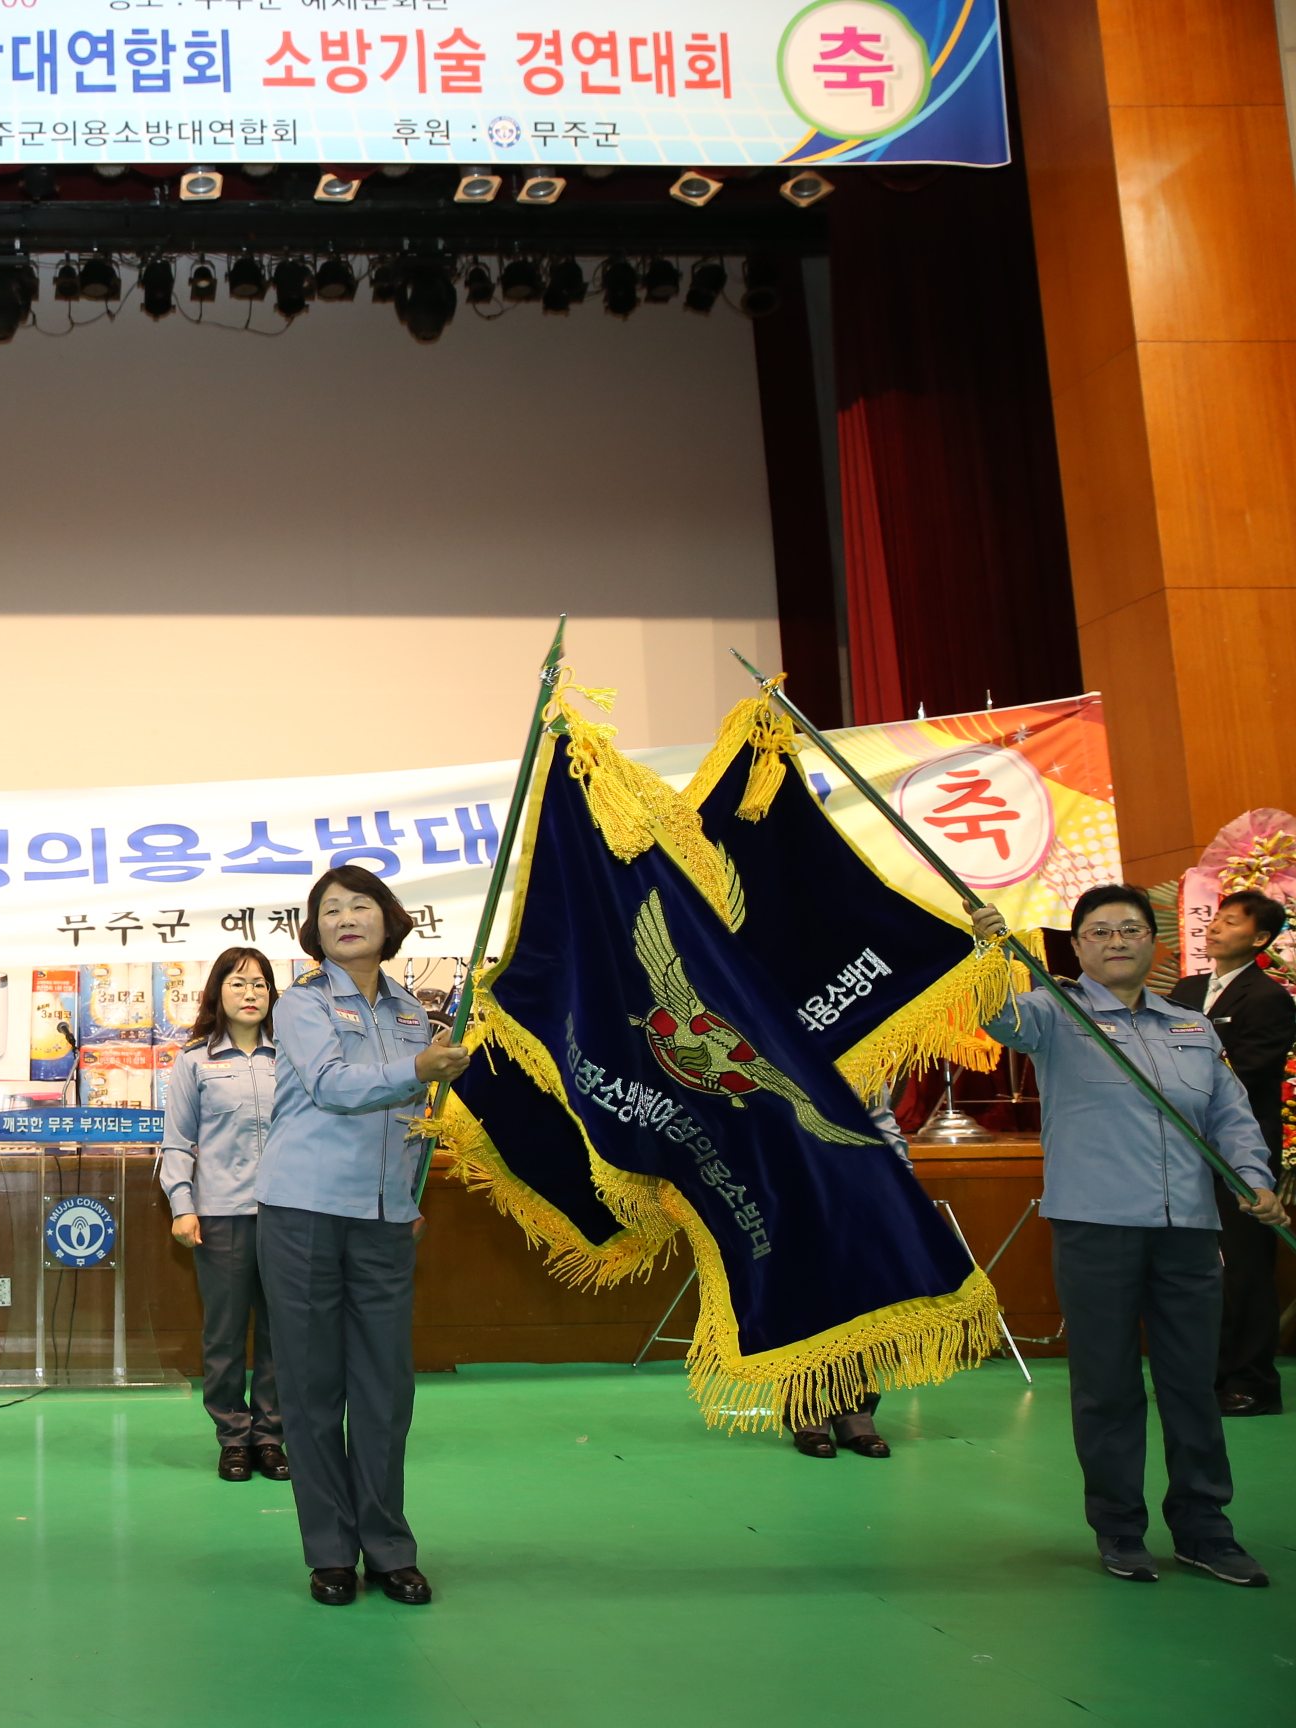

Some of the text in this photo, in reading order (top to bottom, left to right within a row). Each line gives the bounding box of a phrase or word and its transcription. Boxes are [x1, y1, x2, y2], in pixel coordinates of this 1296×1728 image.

[262, 26, 487, 95] 소방기술
[515, 29, 734, 99] 경연대회
[813, 26, 895, 108] 축
[392, 119, 451, 147] 후원
[531, 121, 621, 148] 무주군
[922, 768, 1020, 860] 축
[56, 908, 190, 947] 무주군
[221, 904, 444, 943] 예체관
[2, 1117, 43, 1133] 깨끗한
[48, 1117, 74, 1133] 무주
[80, 1117, 133, 1133] 부자되는
[49, 1197, 113, 1223] MUJU COUNTY
